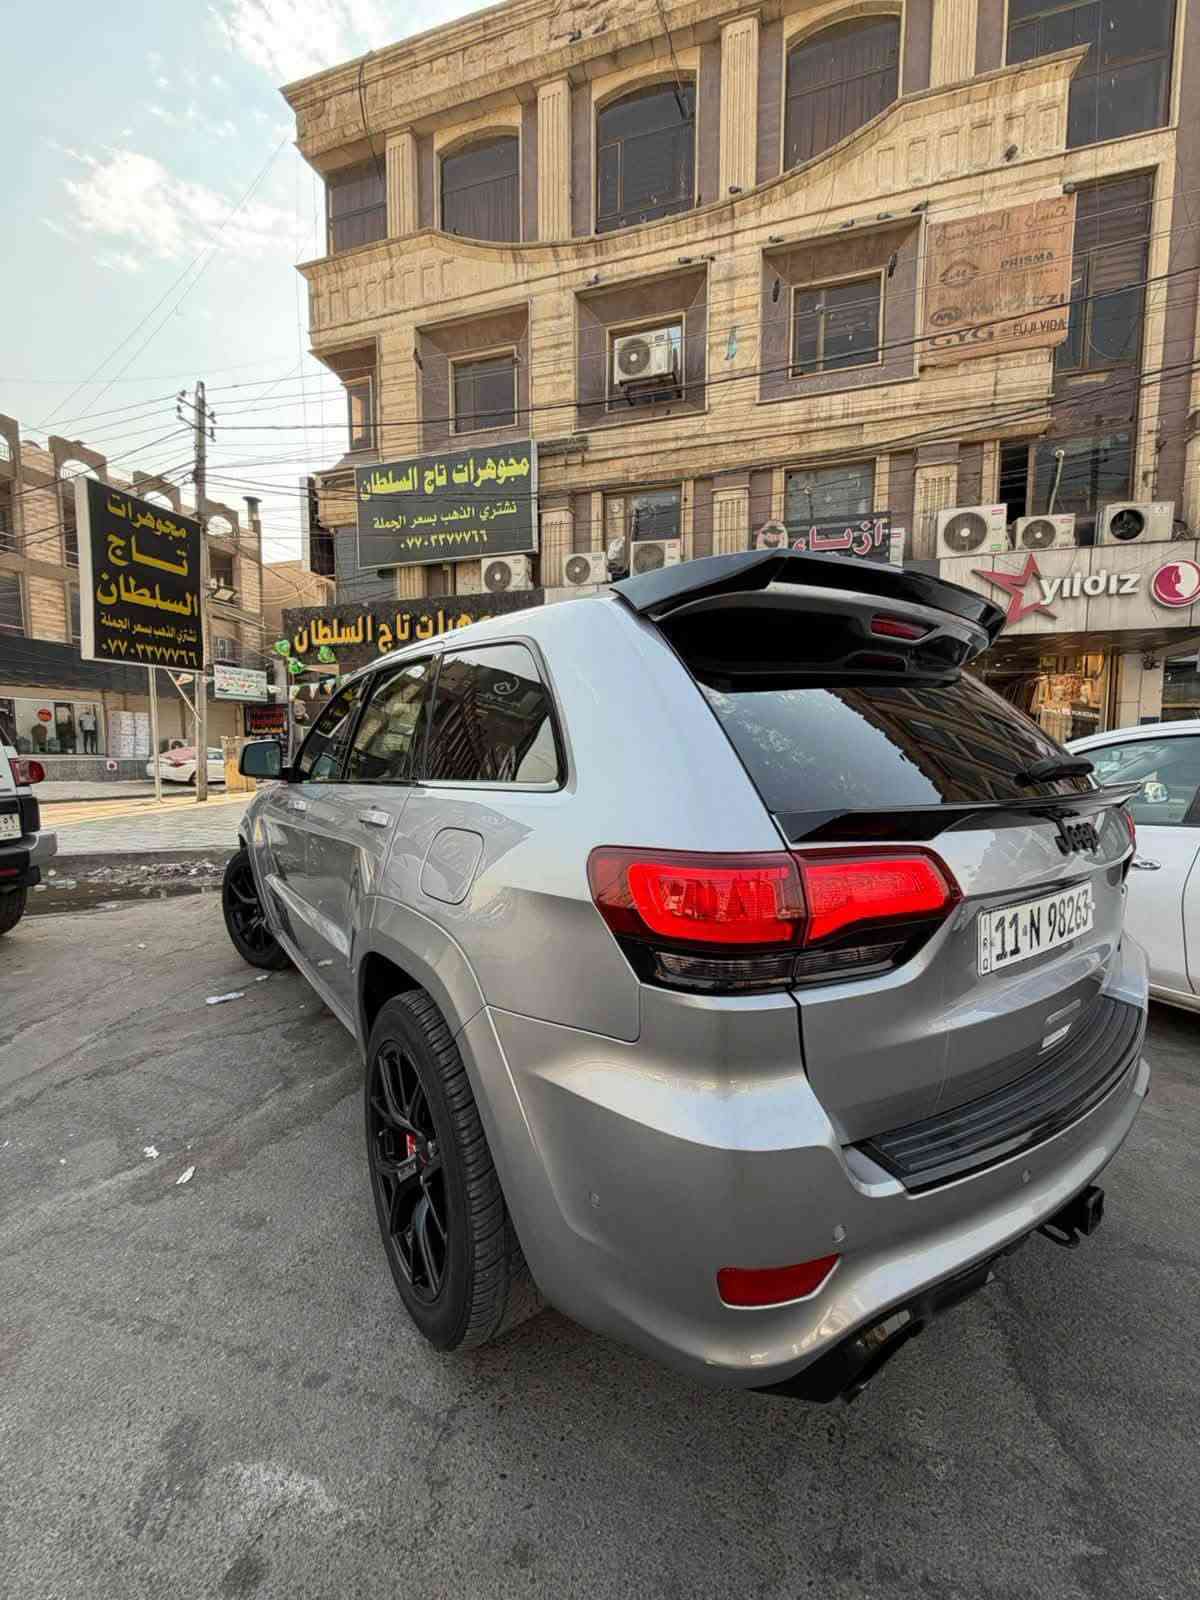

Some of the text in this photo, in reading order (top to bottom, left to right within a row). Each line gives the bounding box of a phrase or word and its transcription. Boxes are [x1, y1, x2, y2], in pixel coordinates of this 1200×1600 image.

[360, 456, 529, 500] مجوهرات تاج السلطان
[106, 494, 187, 540] مجوهرات
[373, 501, 517, 532] نشتري الذهب بسعر الجملة
[96, 572, 198, 616] السلطان
[294, 612, 372, 654] السلطان
[378, 611, 410, 653] تاج
[1055, 819, 1100, 855] Jeep
